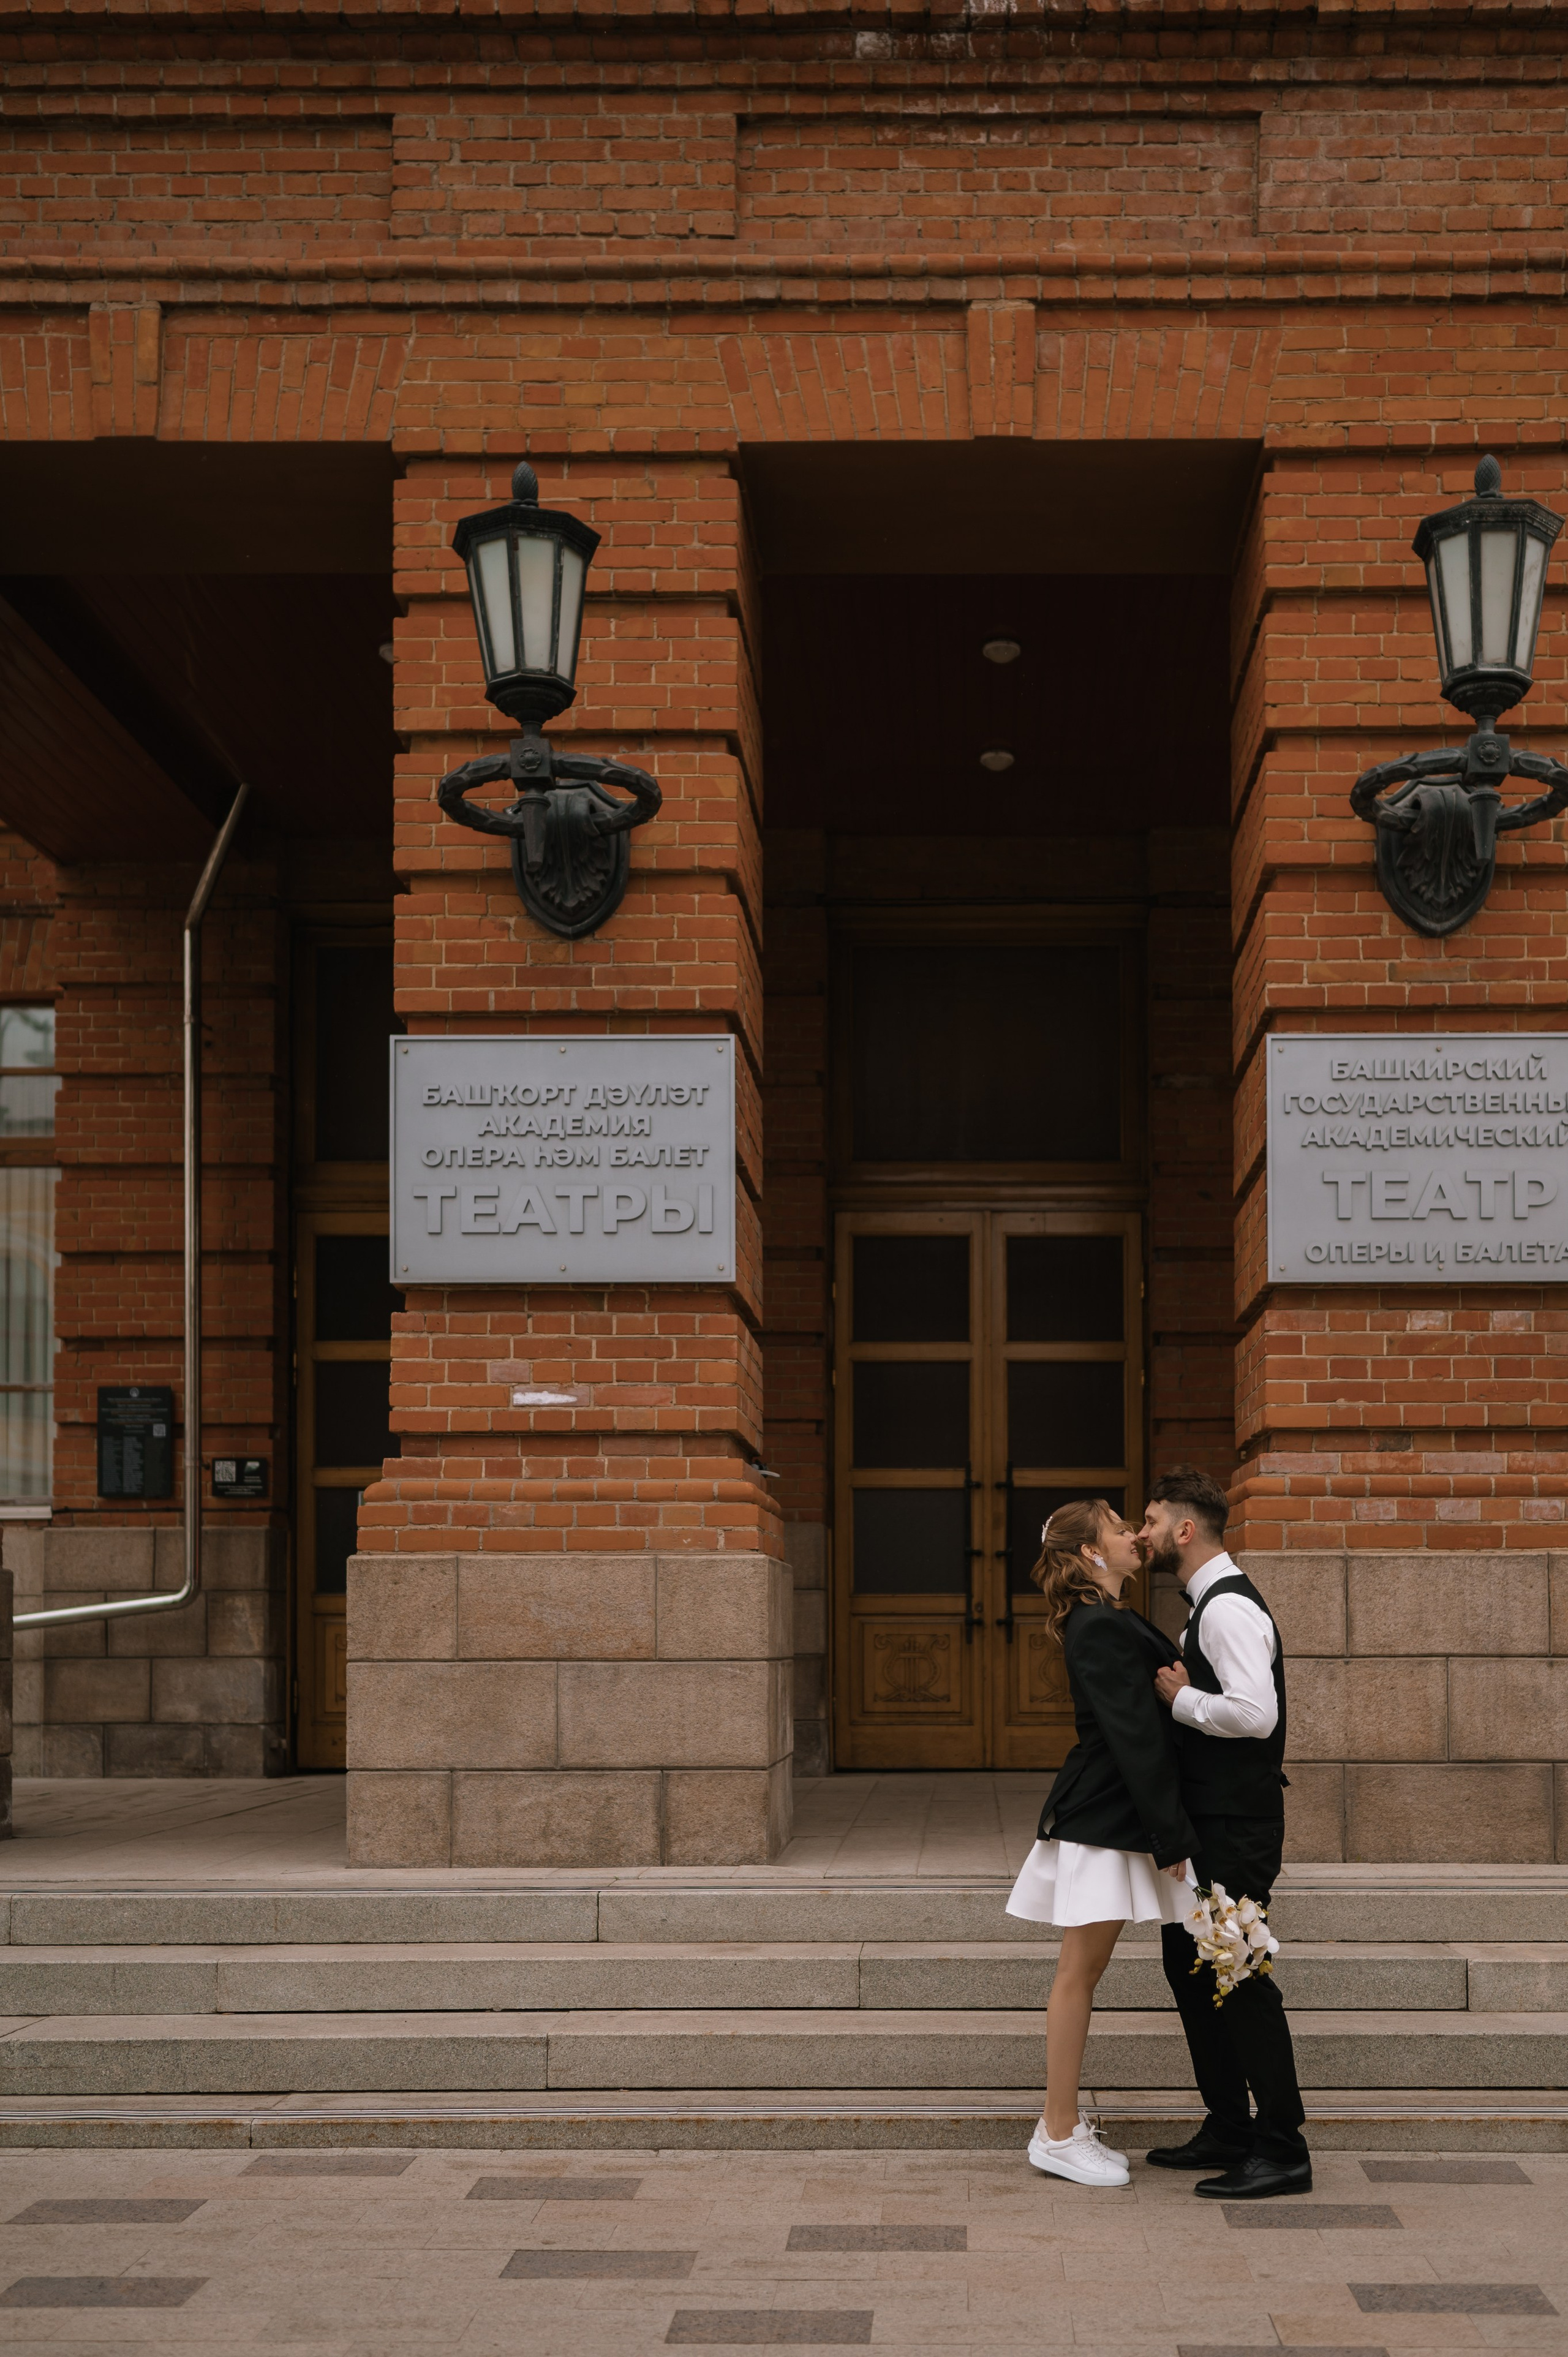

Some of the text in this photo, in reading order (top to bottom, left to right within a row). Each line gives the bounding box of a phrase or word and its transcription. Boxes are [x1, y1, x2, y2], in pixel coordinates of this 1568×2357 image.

[1331, 1052, 1548, 1080] БАШКИРСКИЙ
[478, 1115, 651, 1139] АКАДЕМИЯ
[420, 1145, 524, 1166] ОПЕРА
[610, 1145, 709, 1166] БАЛЕТ
[1322, 1171, 1558, 1220] ТЕАТР
[413, 1185, 713, 1234] ТЕАТРЫ
[1305, 1242, 1568, 1262] ОПЕРЫ И БАЛЕТА
